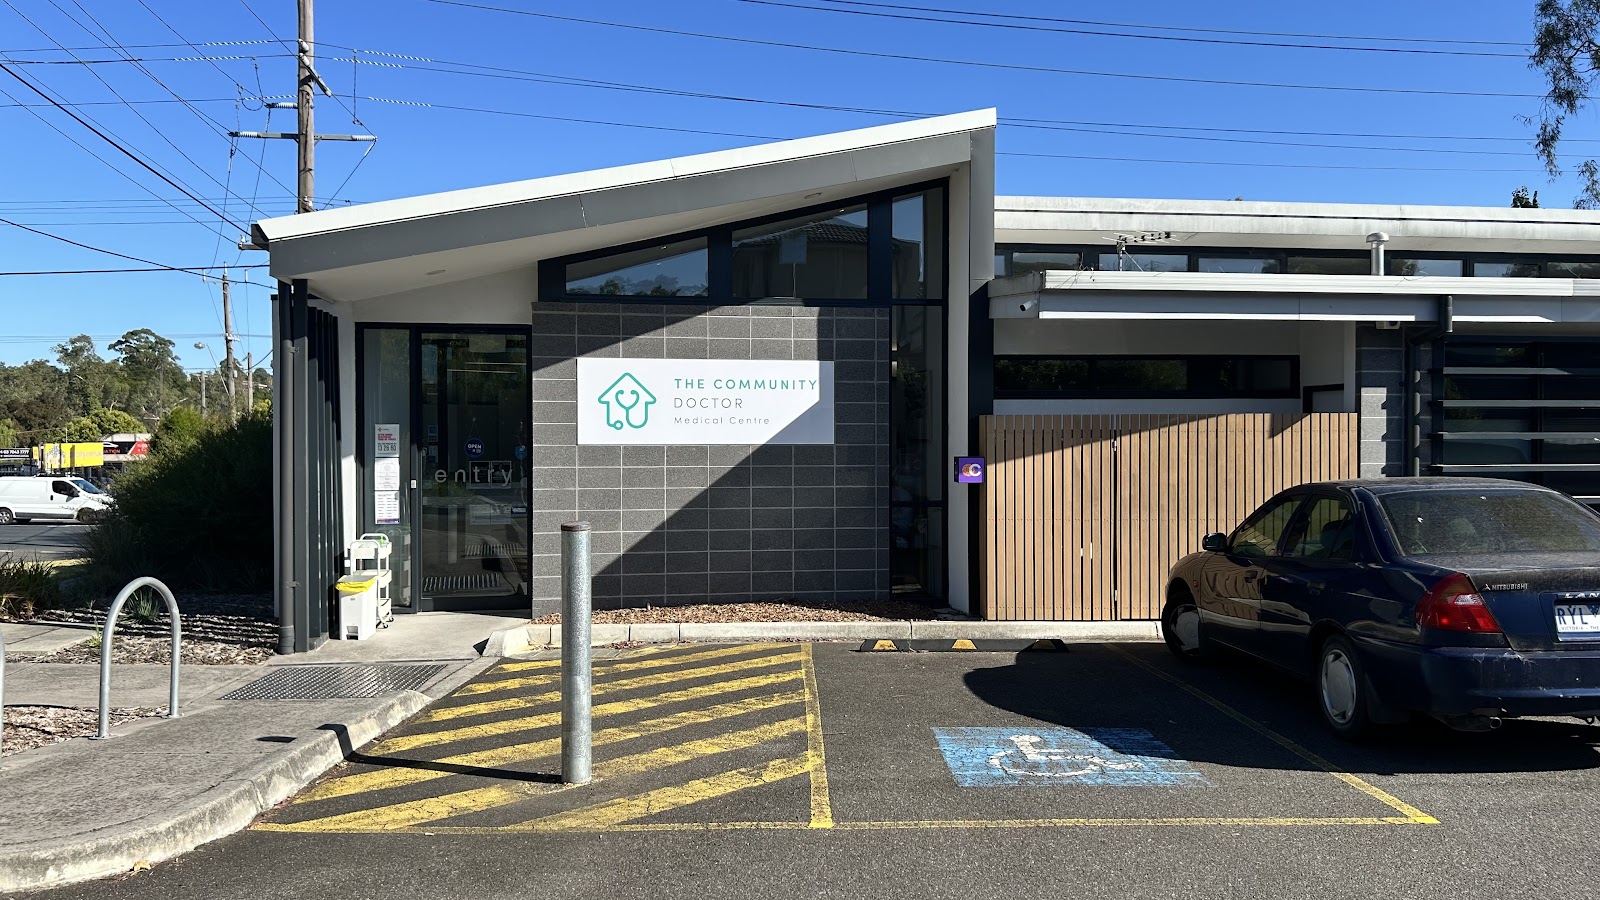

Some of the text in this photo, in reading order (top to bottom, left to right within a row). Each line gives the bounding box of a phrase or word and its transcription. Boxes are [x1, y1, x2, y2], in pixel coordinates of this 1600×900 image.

[674, 378, 818, 391] THE COMMUNITY
[673, 397, 744, 409] DOCTOR
[673, 416, 771, 425] Medical Centre
[434, 465, 513, 487] entry
[1491, 583, 1528, 591] MITSUBISHI
[1557, 607, 1588, 625] RYL
